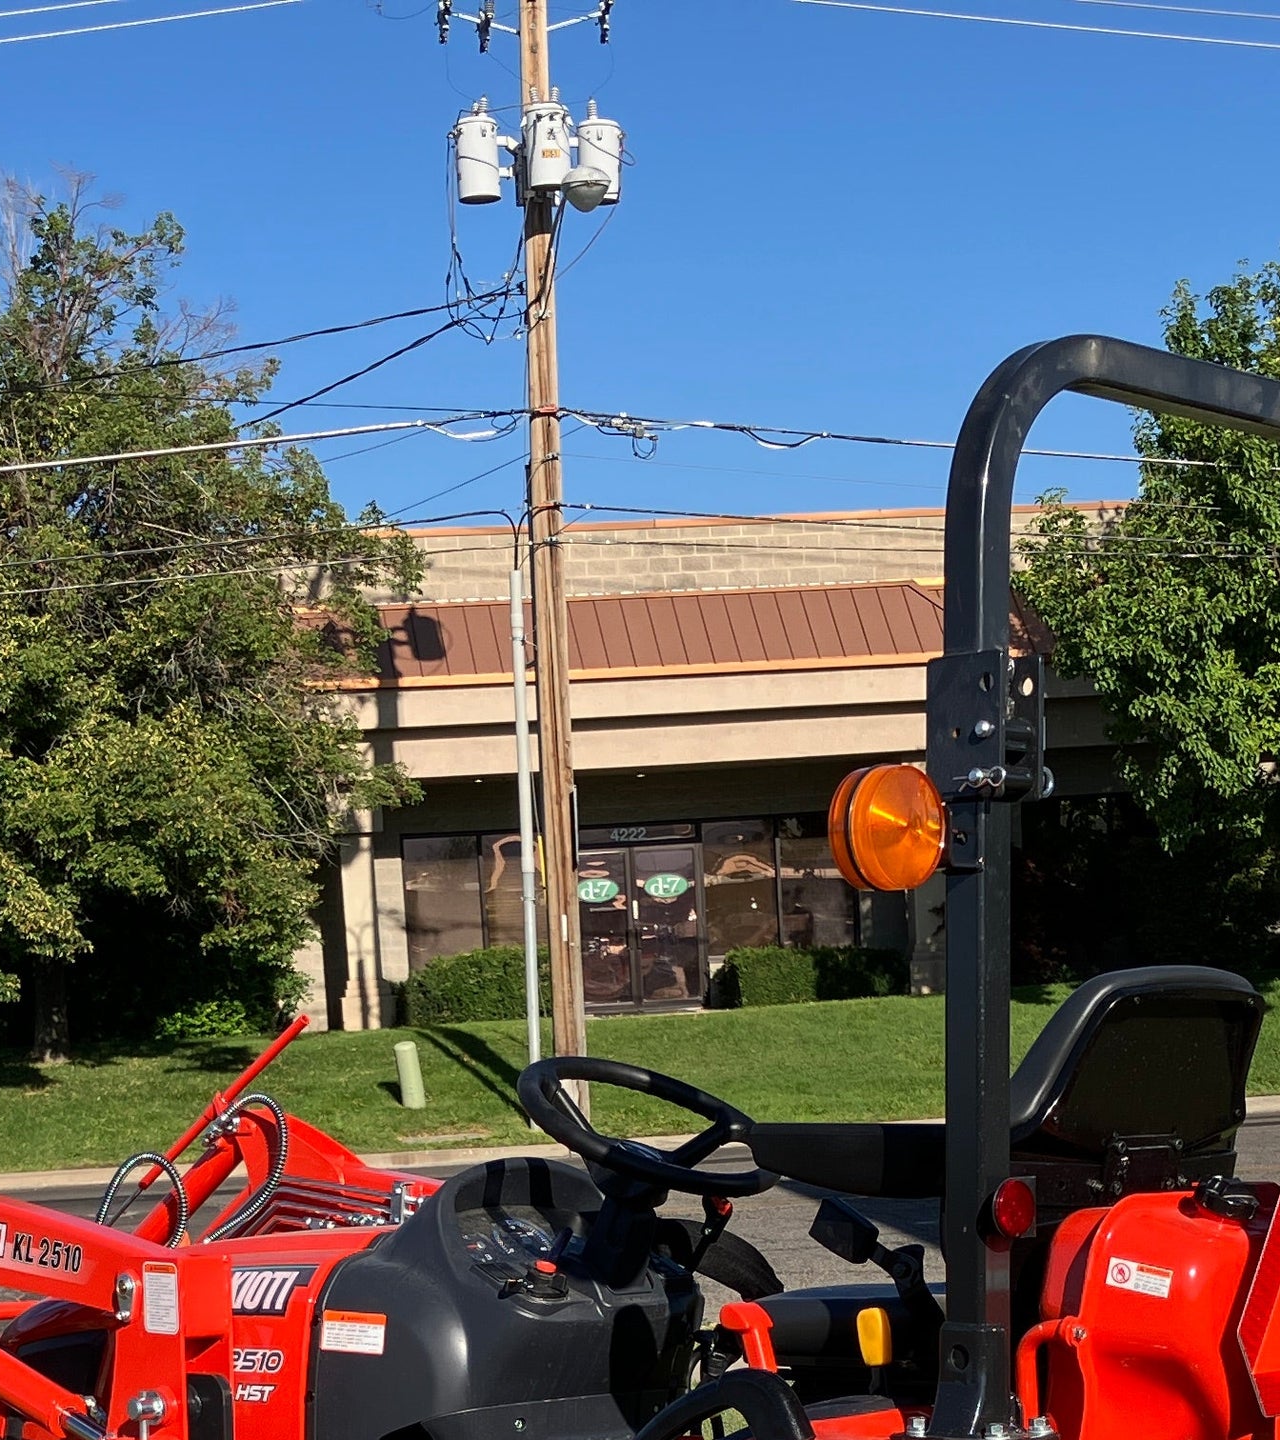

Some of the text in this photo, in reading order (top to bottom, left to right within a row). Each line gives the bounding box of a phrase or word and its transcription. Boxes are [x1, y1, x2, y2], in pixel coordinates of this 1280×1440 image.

[610, 827, 647, 841] 4222
[12, 1232, 34, 1263] KL
[37, 1237, 83, 1274] 2510
[231, 1270, 300, 1311] KIOTI
[234, 1384, 275, 1402] HST
